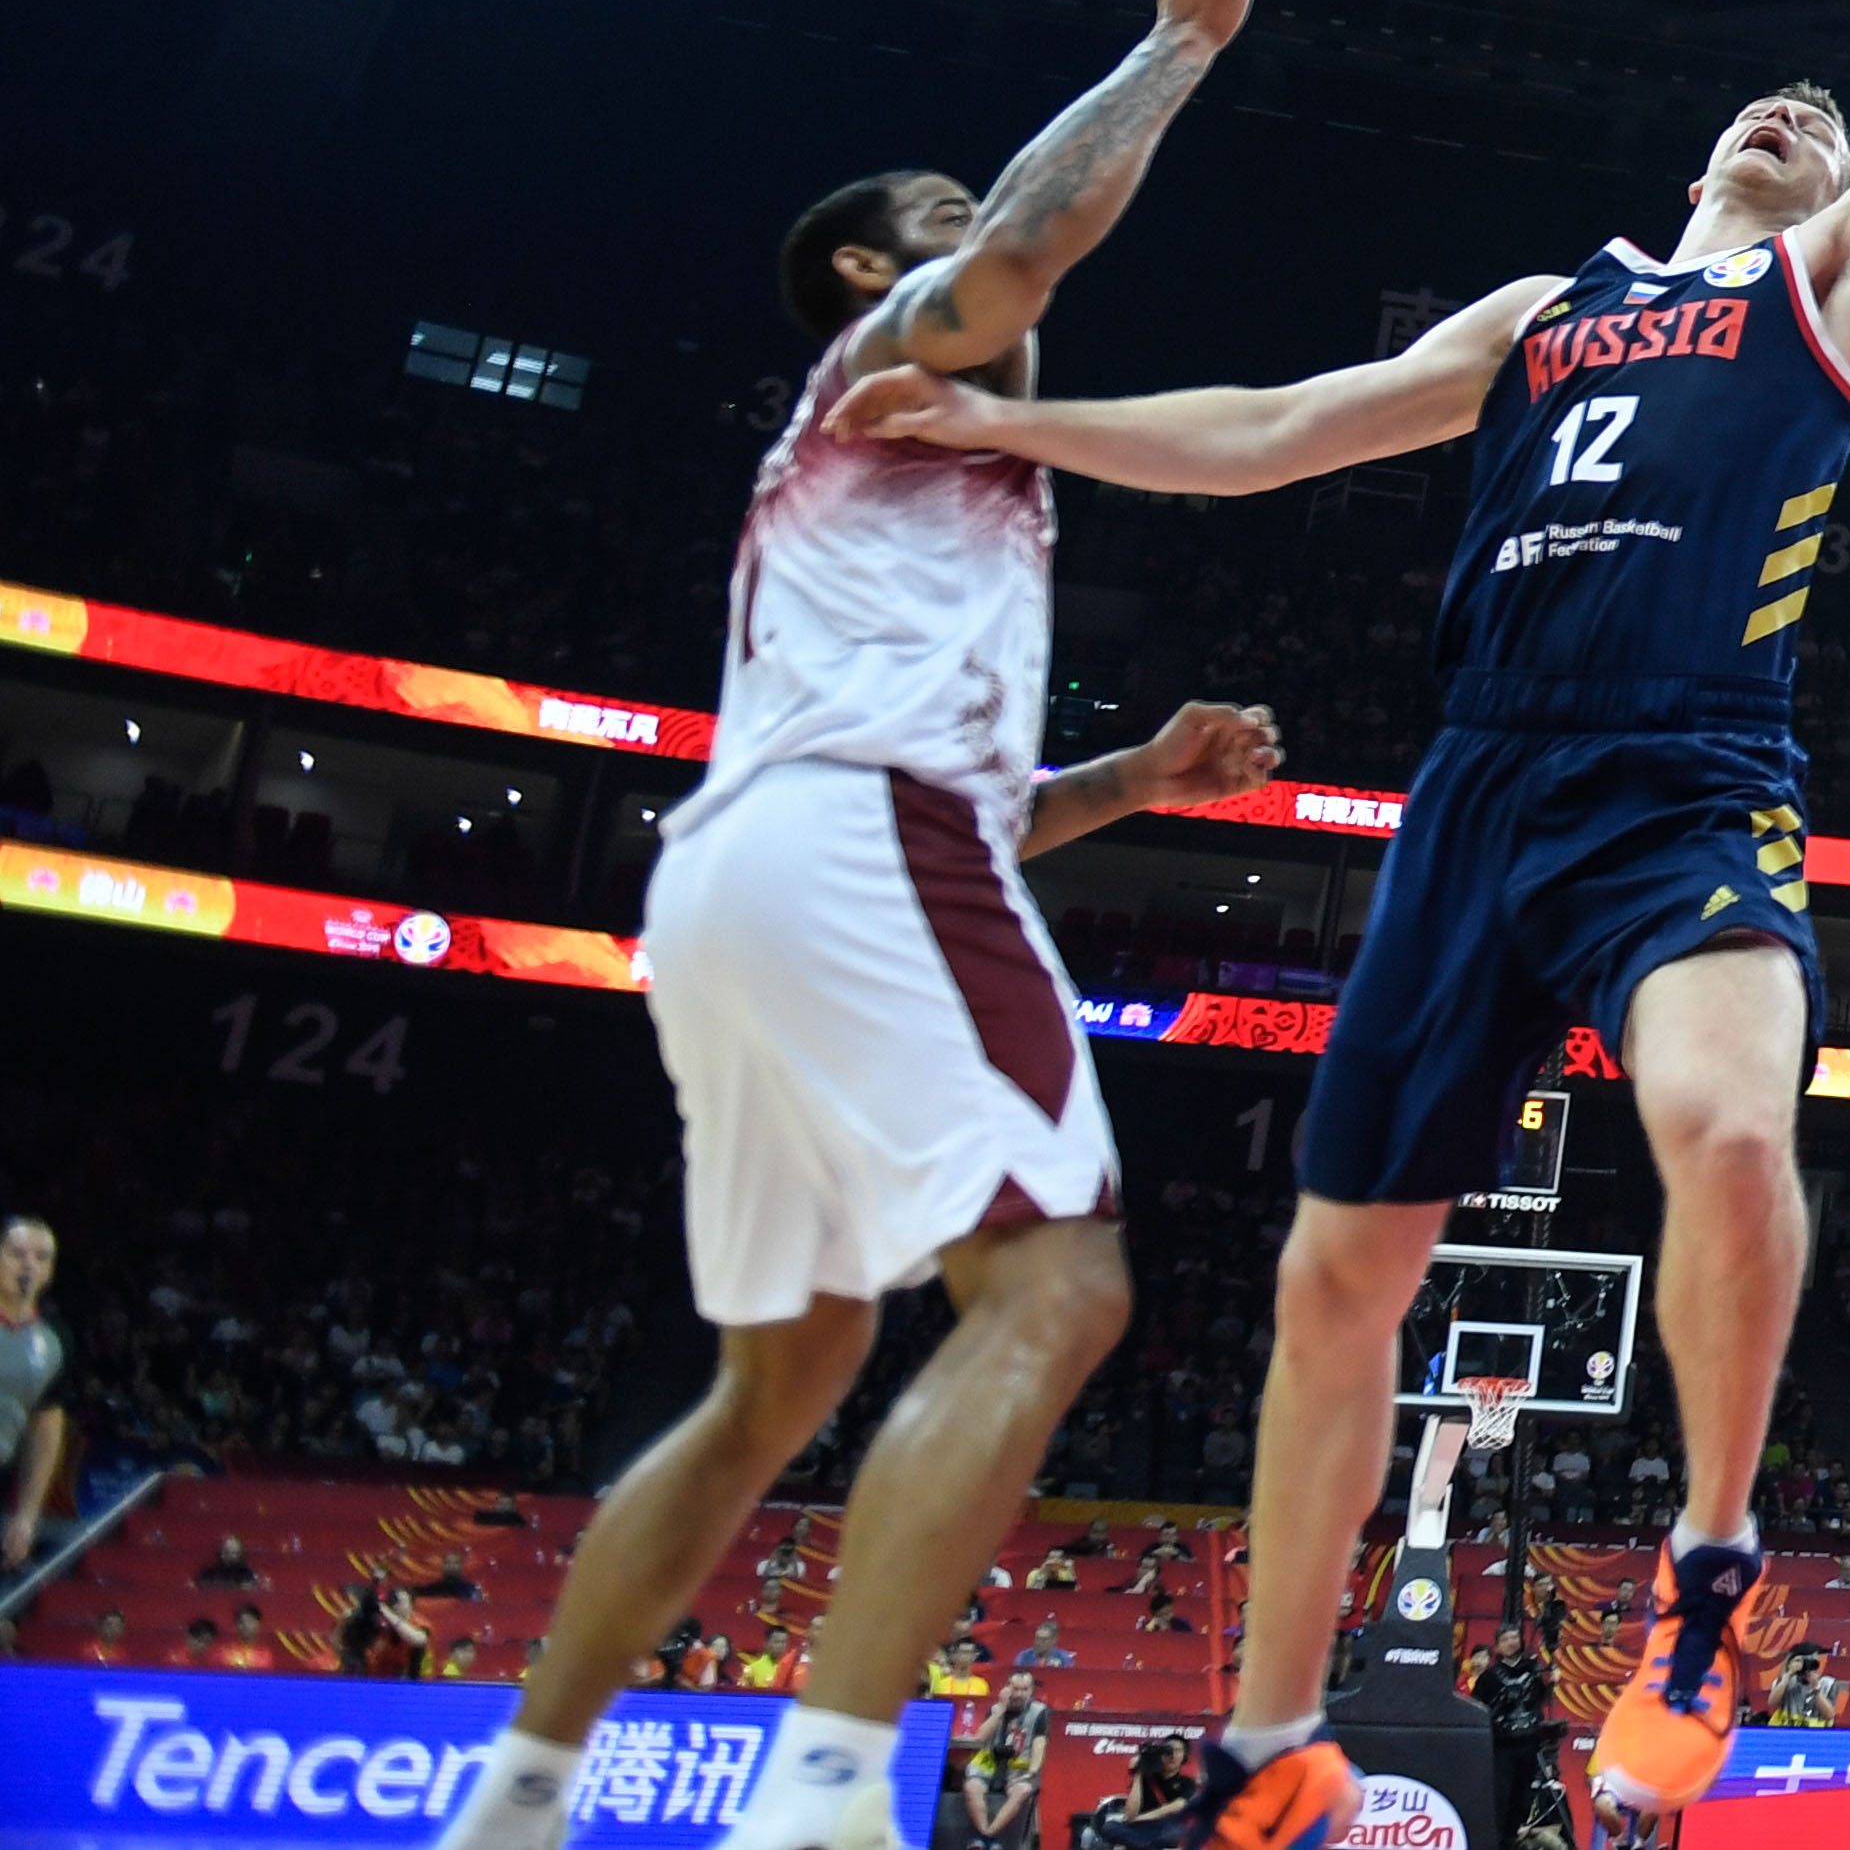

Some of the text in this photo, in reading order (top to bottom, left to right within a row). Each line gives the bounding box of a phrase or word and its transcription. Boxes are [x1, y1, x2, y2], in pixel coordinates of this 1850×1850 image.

[0, 204, 136, 294] 24
[1523, 298, 1750, 405] RUSSIA
[1550, 395, 1641, 486] 12
[1490, 531, 1545, 574] BF
[1602, 518, 1684, 543] Basketball
[211, 992, 410, 1095] 124
[1486, 1194, 1562, 1214] TISSOT
[91, 1697, 512, 1822] Tencen
[1362, 1787, 1429, 1813] 岁山
